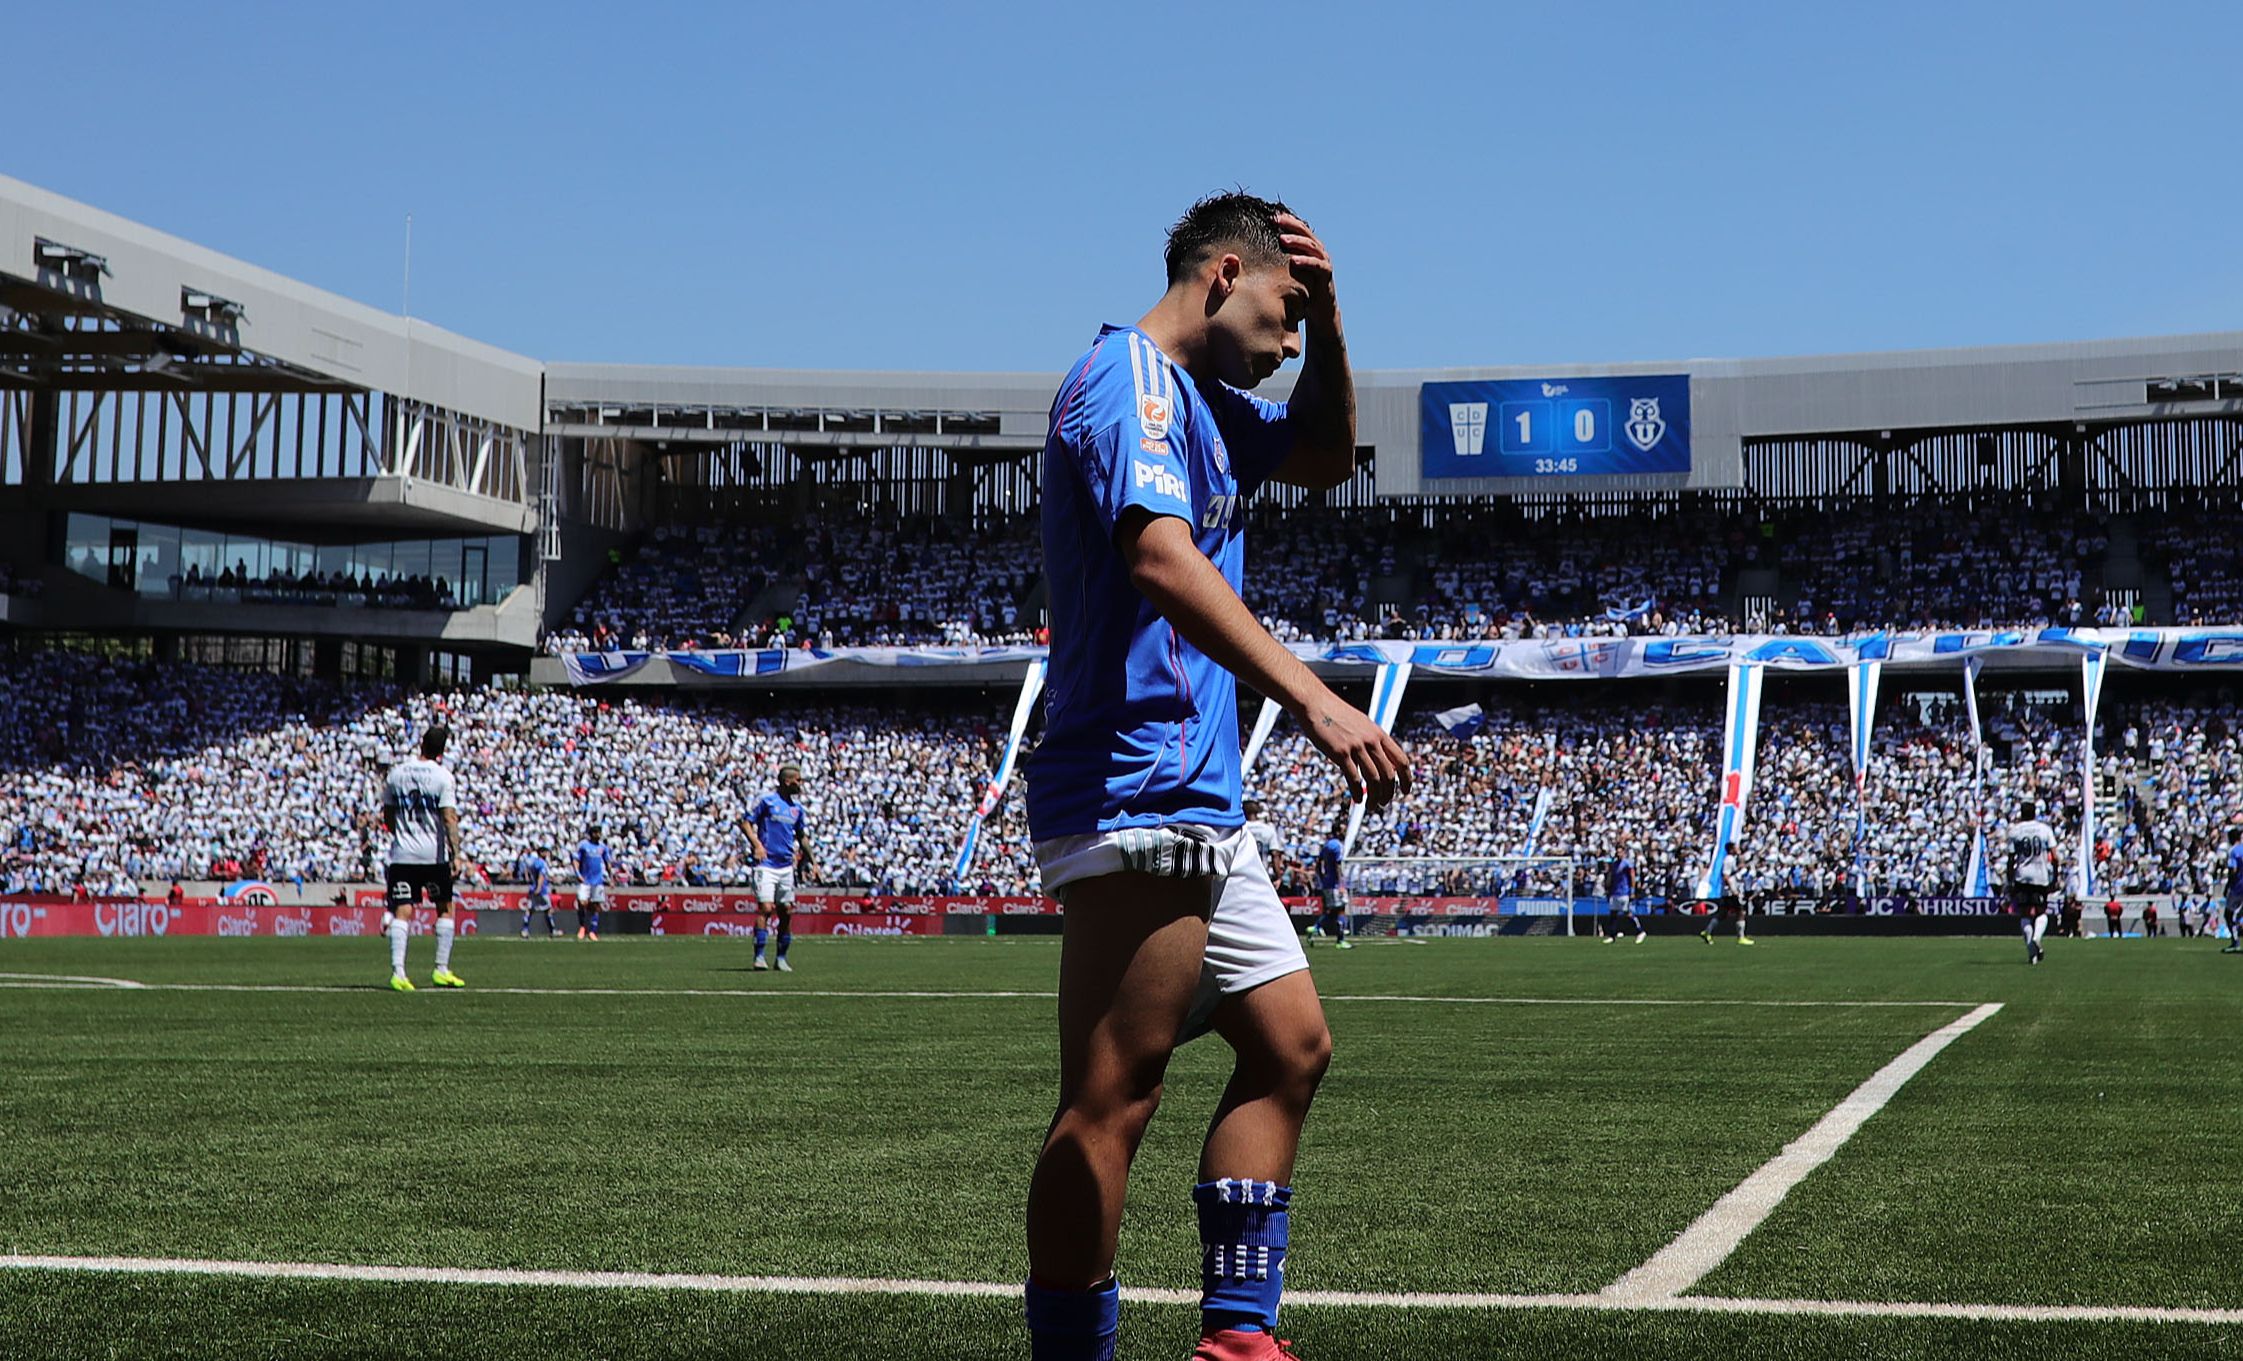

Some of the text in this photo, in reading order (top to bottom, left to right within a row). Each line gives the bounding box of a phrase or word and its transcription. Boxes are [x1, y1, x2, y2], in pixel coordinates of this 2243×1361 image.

[1515, 409, 1594, 443] 1 0
[1535, 458, 1577, 473] 33:45
[683, 897, 718, 913] Claro
[946, 899, 988, 915] Claro
[1003, 900, 1039, 915] Claro
[1446, 903, 1485, 916] Claro
[94, 903, 169, 937] Claro
